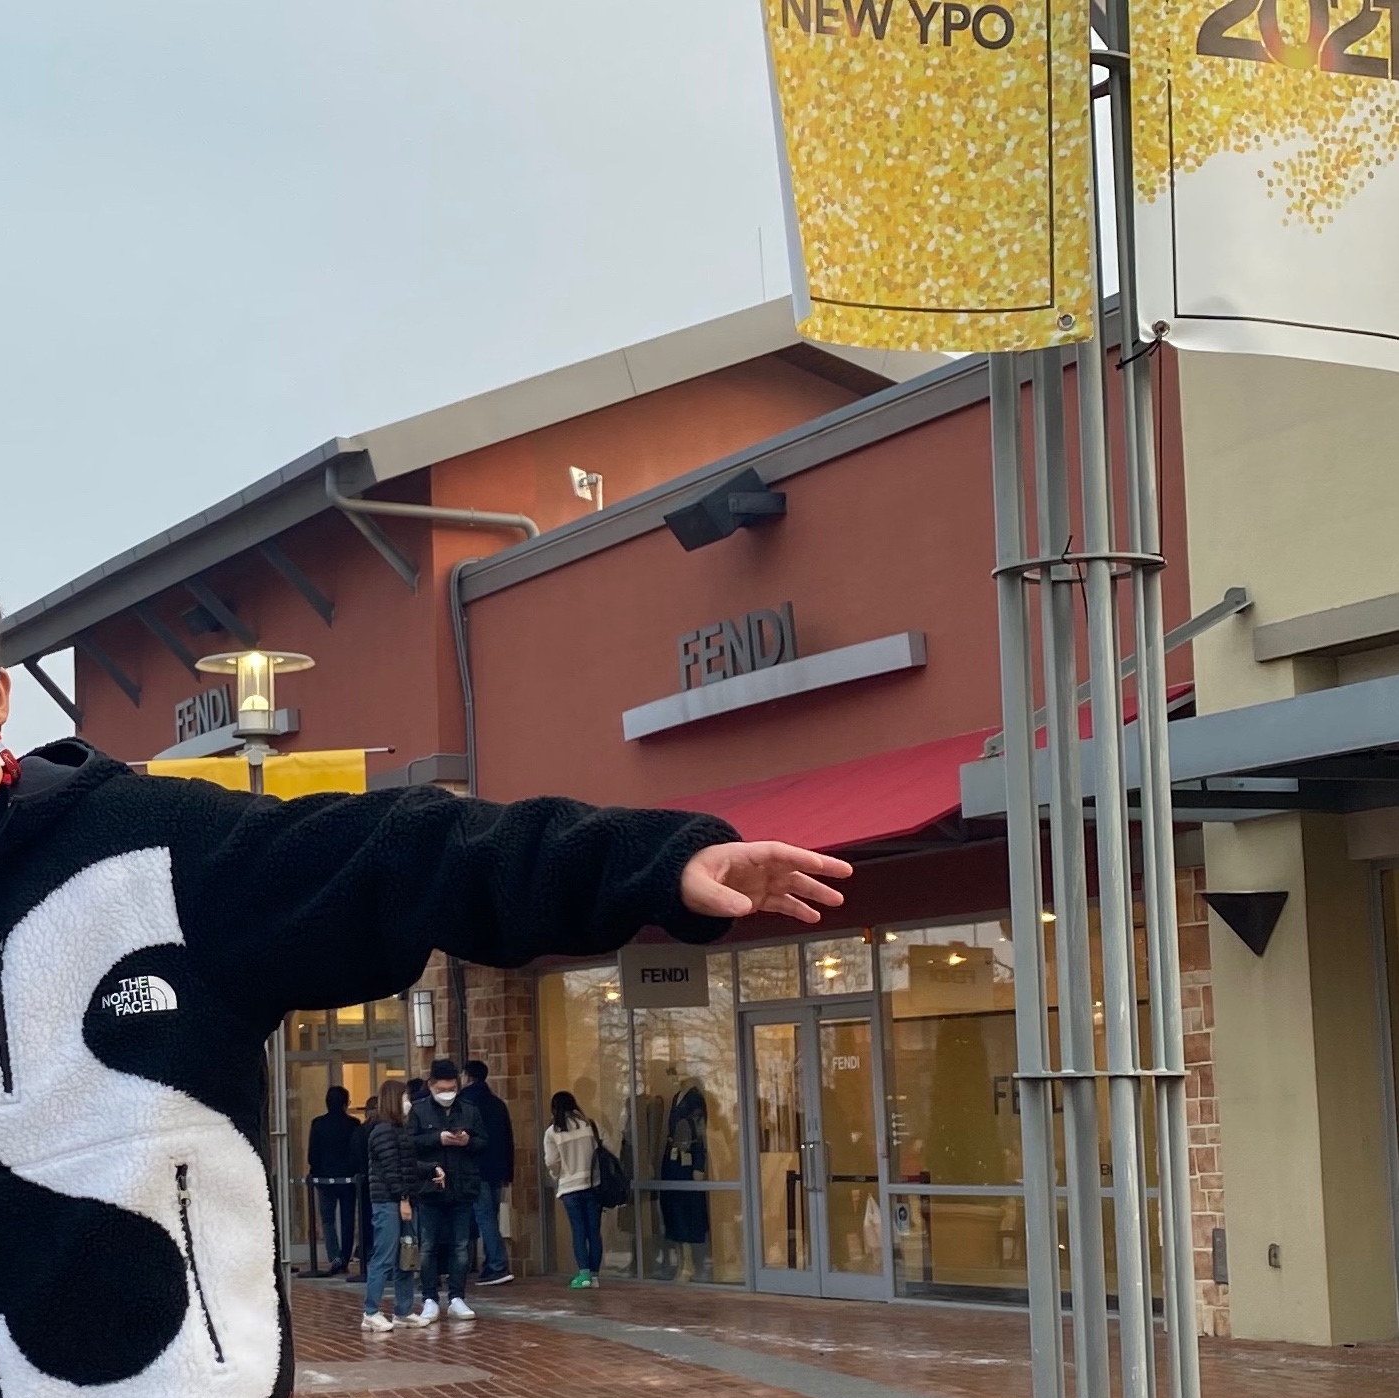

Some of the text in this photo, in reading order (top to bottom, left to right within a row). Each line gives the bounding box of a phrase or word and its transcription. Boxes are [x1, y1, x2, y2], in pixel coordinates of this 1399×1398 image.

[781, 0, 1015, 50] NEW YPO
[678, 600, 799, 692] FENDI
[175, 684, 232, 743] FENDI
[118, 976, 149, 991] THE
[641, 967, 690, 983] FENDI
[102, 988, 150, 1009] NORTH
[115, 1000, 152, 1017] FACE
[832, 1055, 861, 1070] FENDI
